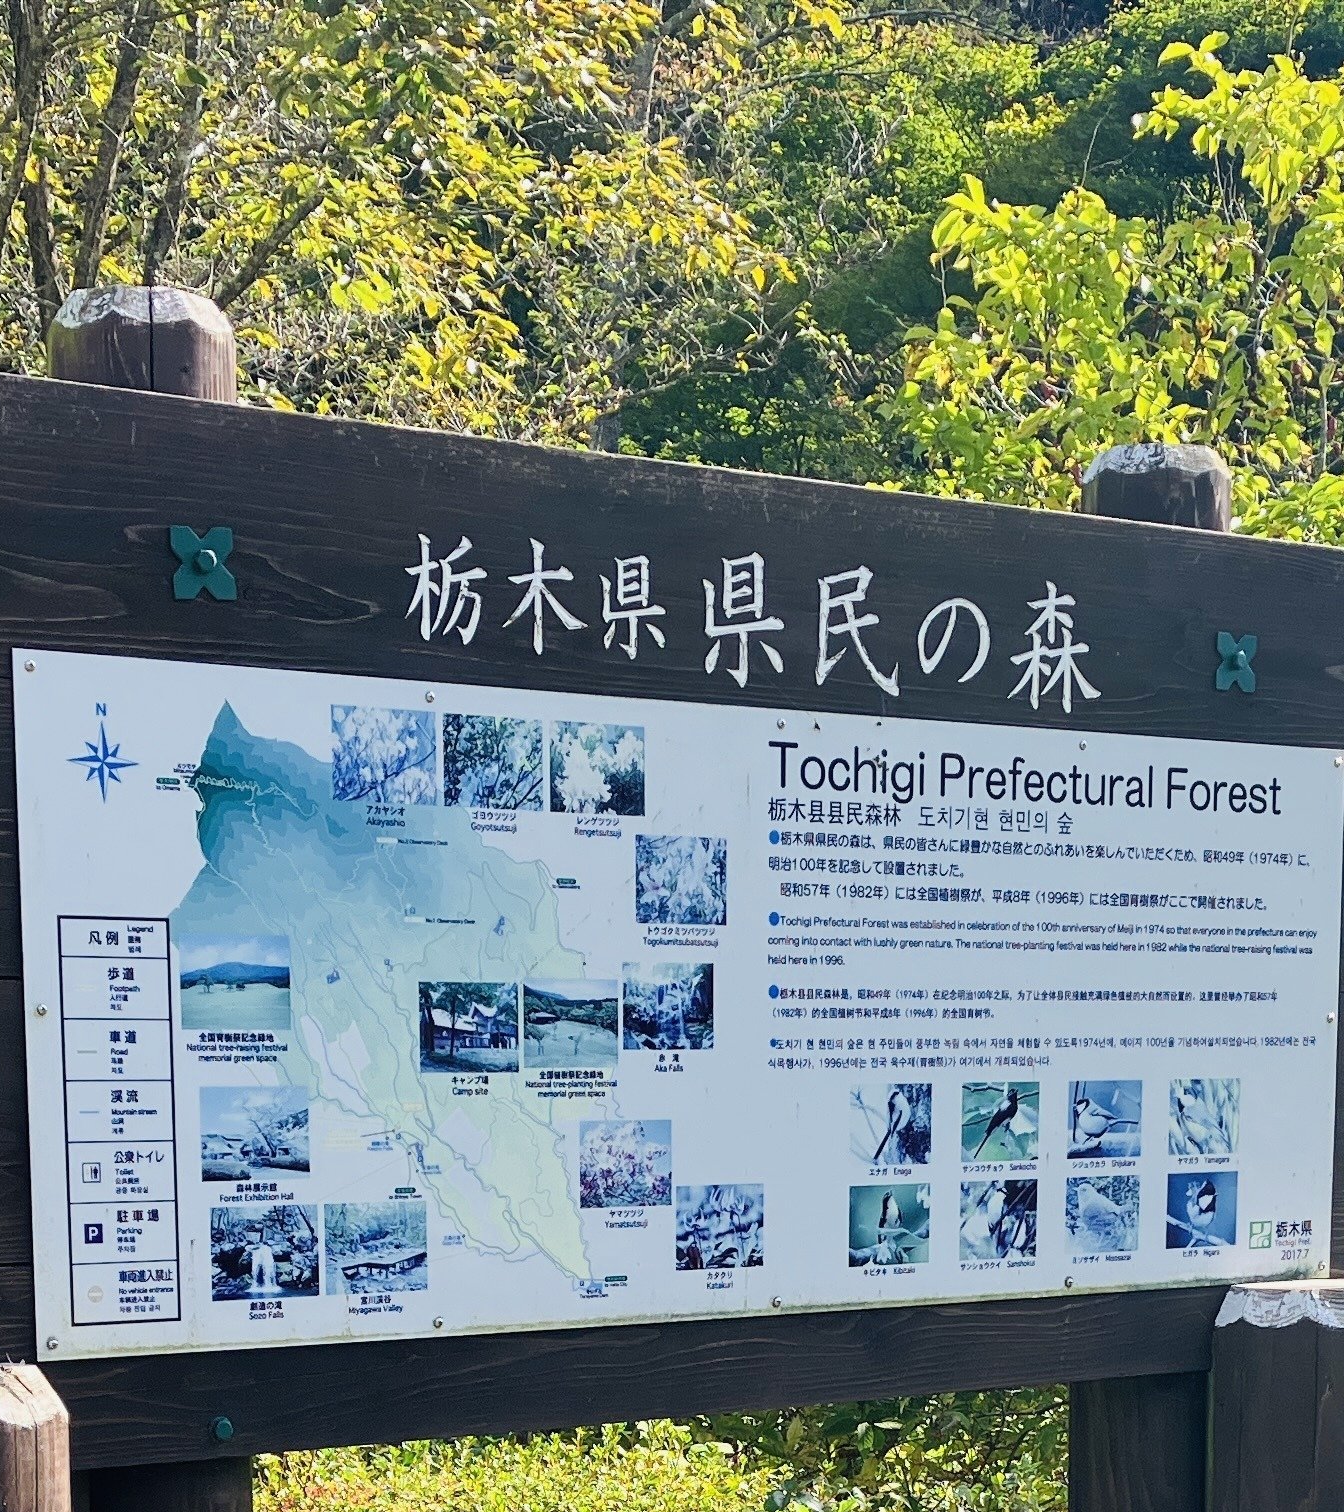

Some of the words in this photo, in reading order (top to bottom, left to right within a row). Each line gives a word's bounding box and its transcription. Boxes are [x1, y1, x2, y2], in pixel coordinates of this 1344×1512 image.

[404, 533, 1102, 713] 栃木県県民の森
[96, 703, 107, 716] N
[768, 741, 925, 804] Tochigi
[940, 752, 1154, 808] Prefectural
[1167, 767, 1282, 815] Forest
[366, 805, 405, 817] アカヤシオ
[471, 811, 516, 821] ゴヨウツツジ
[768, 797, 902, 827] 栃木县县民森林
[366, 816, 405, 828] Akayashio
[576, 816, 619, 826] レンゲツツジ
[918, 806, 989, 831] 도치기현
[999, 808, 1048, 833] 현민의
[1056, 811, 1074, 835] 숲
[471, 821, 517, 834] Goyotsutsuji
[574, 826, 622, 838] Rengetsutsuji
[126, 925, 154, 934] Legend
[780, 915, 812, 928] Tochigi
[813, 916, 861, 928] Prefectural
[862, 917, 889, 929] Forest
[891, 920, 908, 929] was
[910, 919, 956, 930] established
[957, 920, 965, 930] in
[966, 920, 1010, 931] celebration
[1012, 921, 1020, 931] of
[1021, 921, 1034, 932] the
[1036, 921, 1060, 932] 100th
[1061, 923, 1106, 934] anniversary
[1107, 923, 1116, 934] of
[1117, 924, 1134, 935] Meiji
[1135, 924, 1142, 934] in
[1144, 924, 1165, 934] 1974
[1166, 926, 1175, 934] so
[1176, 925, 1191, 935] that
[1192, 926, 1225, 937] everyone
[1227, 926, 1233, 935] in
[1235, 927, 1246, 936] the
[1247, 927, 1283, 938] prefecture
[1284, 929, 1297, 937] can
[1298, 929, 1317, 939] enjoy
[88, 930, 119, 946] 凡例
[767, 936, 800, 947] coming
[801, 936, 818, 946] into
[819, 937, 852, 947] contact
[853, 937, 872, 947] with
[873, 937, 897, 949] lushly
[899, 939, 923, 950] green
[925, 939, 953, 949] nature.
[956, 938, 970, 949] The
[972, 940, 1003, 949] national
[1005, 940, 1055, 952] tree-planting
[1056, 941, 1083, 951] festival
[1085, 943, 1100, 951] was
[1102, 941, 1118, 951] held
[1119, 941, 1136, 952] here
[1137, 942, 1145, 952] in
[1146, 942, 1167, 952] 1982
[1168, 942, 1187, 952] while
[1189, 943, 1200, 953] the
[1202, 943, 1230, 953] national
[1231, 944, 1271, 955] tree-raising
[1272, 944, 1297, 954] festival
[767, 954, 787, 965] held
[788, 954, 808, 965] here
[809, 954, 817, 965] in
[819, 955, 846, 965] 1996.
[107, 966, 135, 981] 歩道
[109, 984, 141, 993] Footpath
[109, 1030, 137, 1044] 車道
[186, 1043, 216, 1052] National
[218, 1043, 260, 1054] tree-raising
[261, 1043, 288, 1052] festival
[1044, 1038, 1051, 1048] 수
[110, 1048, 129, 1056] Road
[198, 1054, 231, 1062] memorial
[233, 1055, 254, 1063] green
[256, 1055, 277, 1063] space
[654, 1064, 667, 1072] Aka
[669, 1064, 684, 1072] Falls
[451, 1076, 489, 1085] キャンプ場
[525, 1080, 551, 1088] National
[553, 1080, 594, 1089] tree-planting
[594, 1080, 618, 1088] festival
[452, 1087, 472, 1098] Camp
[474, 1087, 488, 1096] site
[537, 1090, 566, 1098] memorial
[568, 1091, 586, 1099] green
[587, 1091, 606, 1099] space
[114, 1150, 165, 1164] 公衆トイレ
[1177, 1157, 1199, 1165] ヤマガラ
[1204, 1156, 1230, 1165] Yamagara
[962, 1164, 1004, 1173] サンコウチョウ
[1009, 1162, 1037, 1171] Sankocho
[1072, 1160, 1106, 1168] シジュウカラ
[1111, 1159, 1136, 1168] Shijukara
[115, 1168, 134, 1176] Toilet
[869, 1167, 888, 1176] エナガ
[893, 1167, 912, 1176] Enaga
[219, 1194, 243, 1202] Forest
[244, 1193, 279, 1202] Exhibition
[281, 1192, 294, 1200] Hall
[116, 1208, 160, 1223] 駐車場
[609, 1209, 644, 1218] ヤマツツジ
[605, 1219, 648, 1229] Yamatsutsuji
[1276, 1220, 1312, 1238] 栃木県
[88, 1226, 99, 1241] P
[116, 1227, 142, 1235] Parking
[1275, 1239, 1297, 1247] Tochigi
[118, 1268, 173, 1283] 車両進入禁止
[706, 1271, 733, 1280] カタクリ
[706, 1280, 733, 1290] Katakuri
[348, 1306, 381, 1315] Miyagawa
[382, 1304, 403, 1314] Valley
[249, 1312, 266, 1320] Sozo
[268, 1311, 284, 1319] Falls
